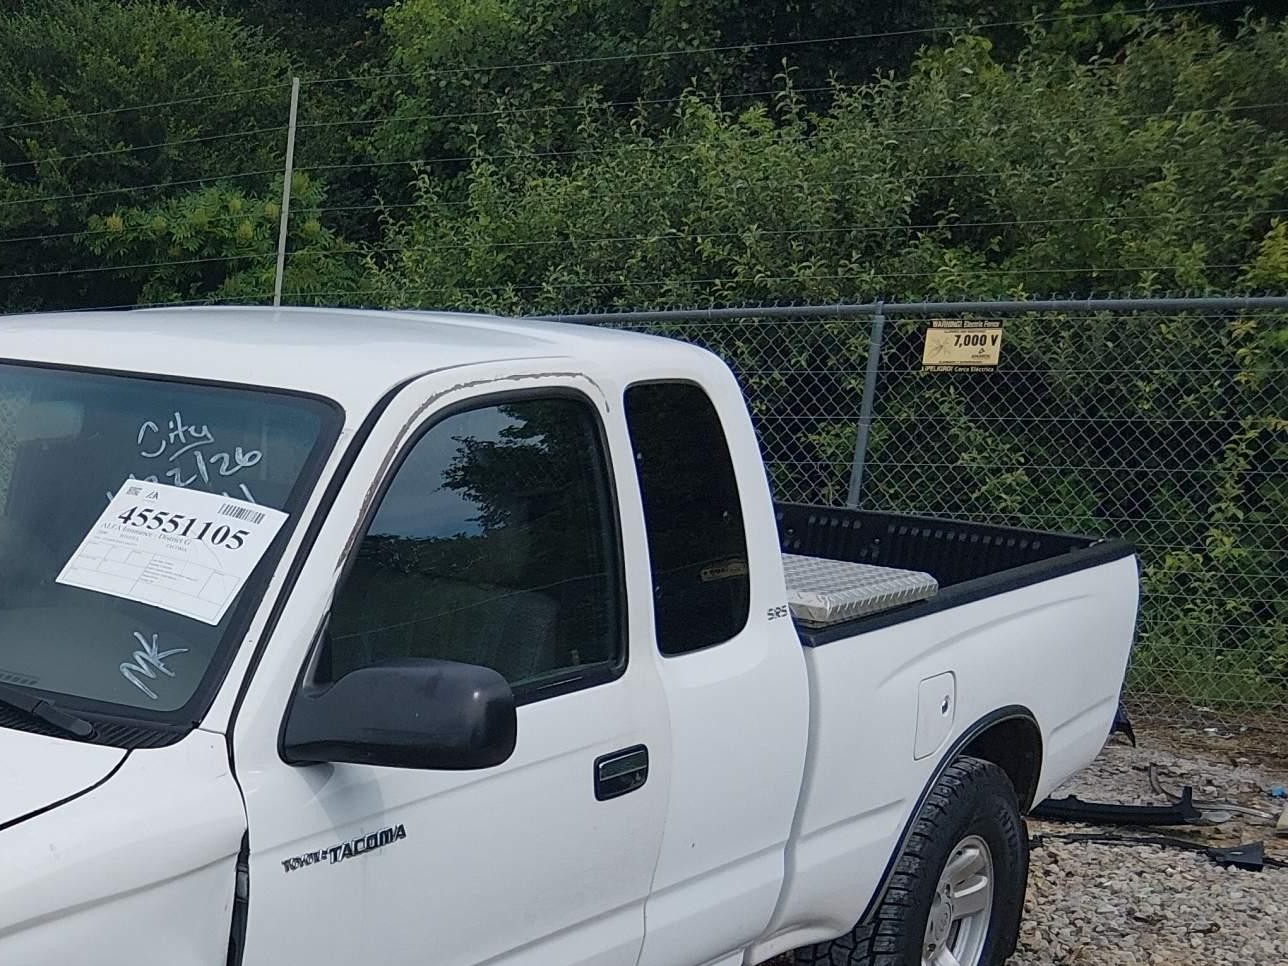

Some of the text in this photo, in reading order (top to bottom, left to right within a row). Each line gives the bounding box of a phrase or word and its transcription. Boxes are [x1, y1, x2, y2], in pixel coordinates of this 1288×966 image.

[953, 334, 999, 348] 7,000 V
[137, 411, 214, 461] City
[118, 506, 250, 550] 45551105
[328, 823, 407, 866] TACOMA
